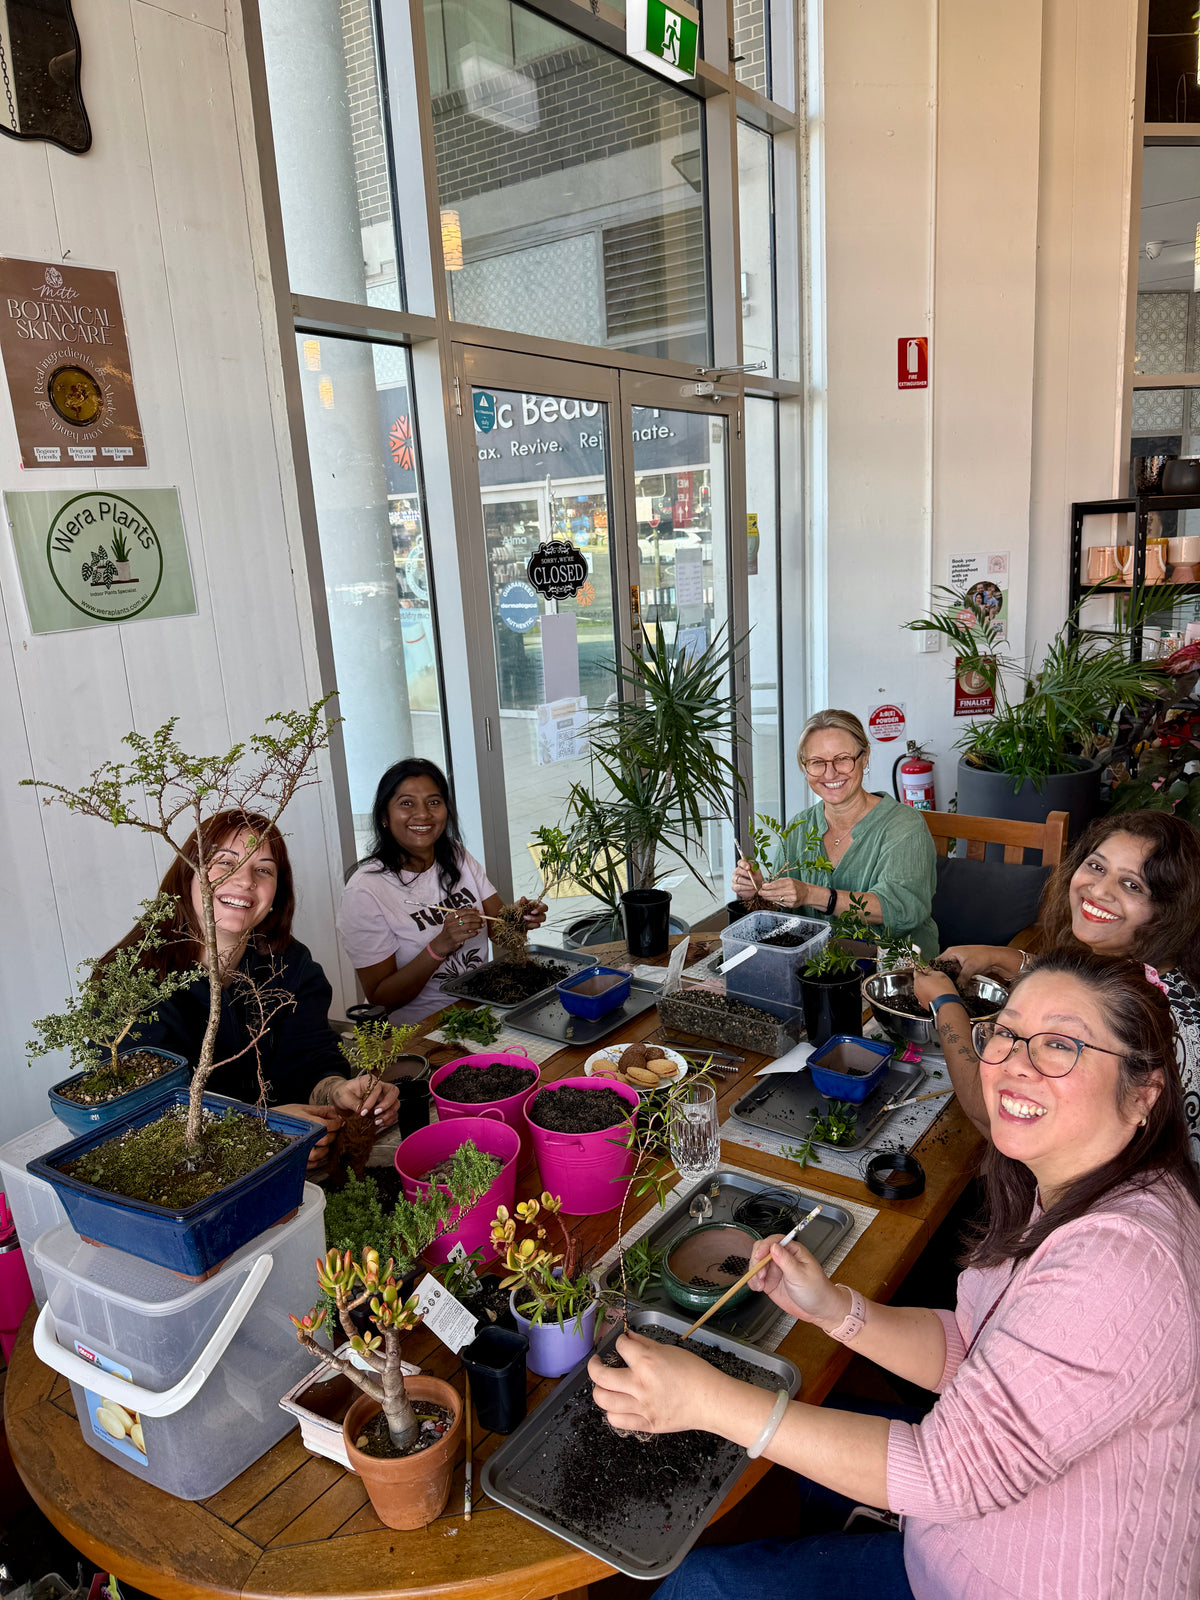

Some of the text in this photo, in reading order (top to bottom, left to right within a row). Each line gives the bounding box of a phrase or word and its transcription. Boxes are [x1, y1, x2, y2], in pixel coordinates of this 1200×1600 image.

[7, 298, 116, 327] BOTANICAL
[16, 319, 113, 345] SKINCARE
[40, 346, 94, 369] ingredients
[34, 366, 45, 394] Real
[50, 417, 79, 443] hands
[511, 439, 563, 456] Revive.
[51, 501, 154, 553] Wera Plants
[534, 564, 583, 585] CLOSED
[502, 581, 534, 597] GUARANTEED
[80, 594, 148, 616] www.weraplants.com.au
[506, 617, 534, 629] AUTHENTIC
[959, 699, 991, 707] FINALIST
[876, 716, 899, 724] POWDER
